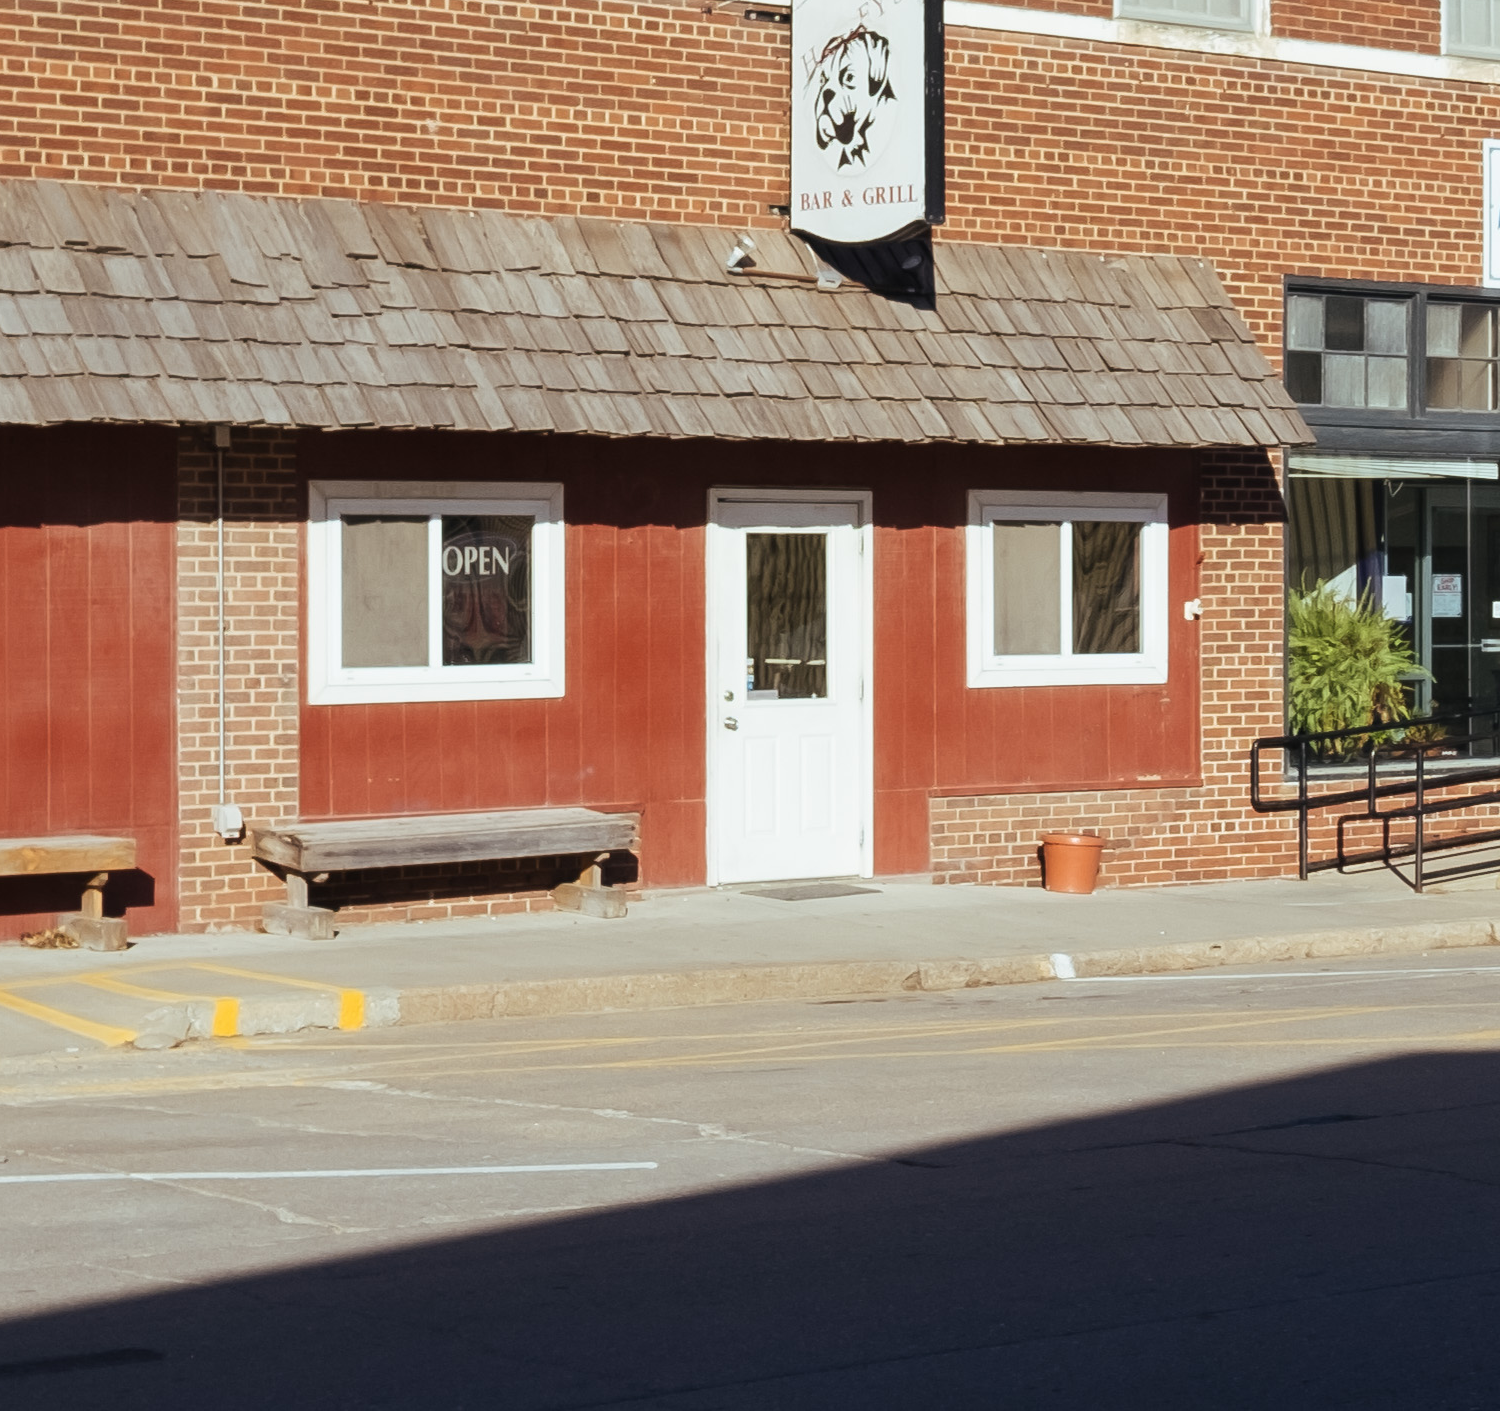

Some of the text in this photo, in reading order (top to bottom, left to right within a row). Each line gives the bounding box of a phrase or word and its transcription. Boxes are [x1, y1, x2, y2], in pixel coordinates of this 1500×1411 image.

[800, 184, 918, 211] BAR & GRILL
[442, 546, 509, 576] OPEN
